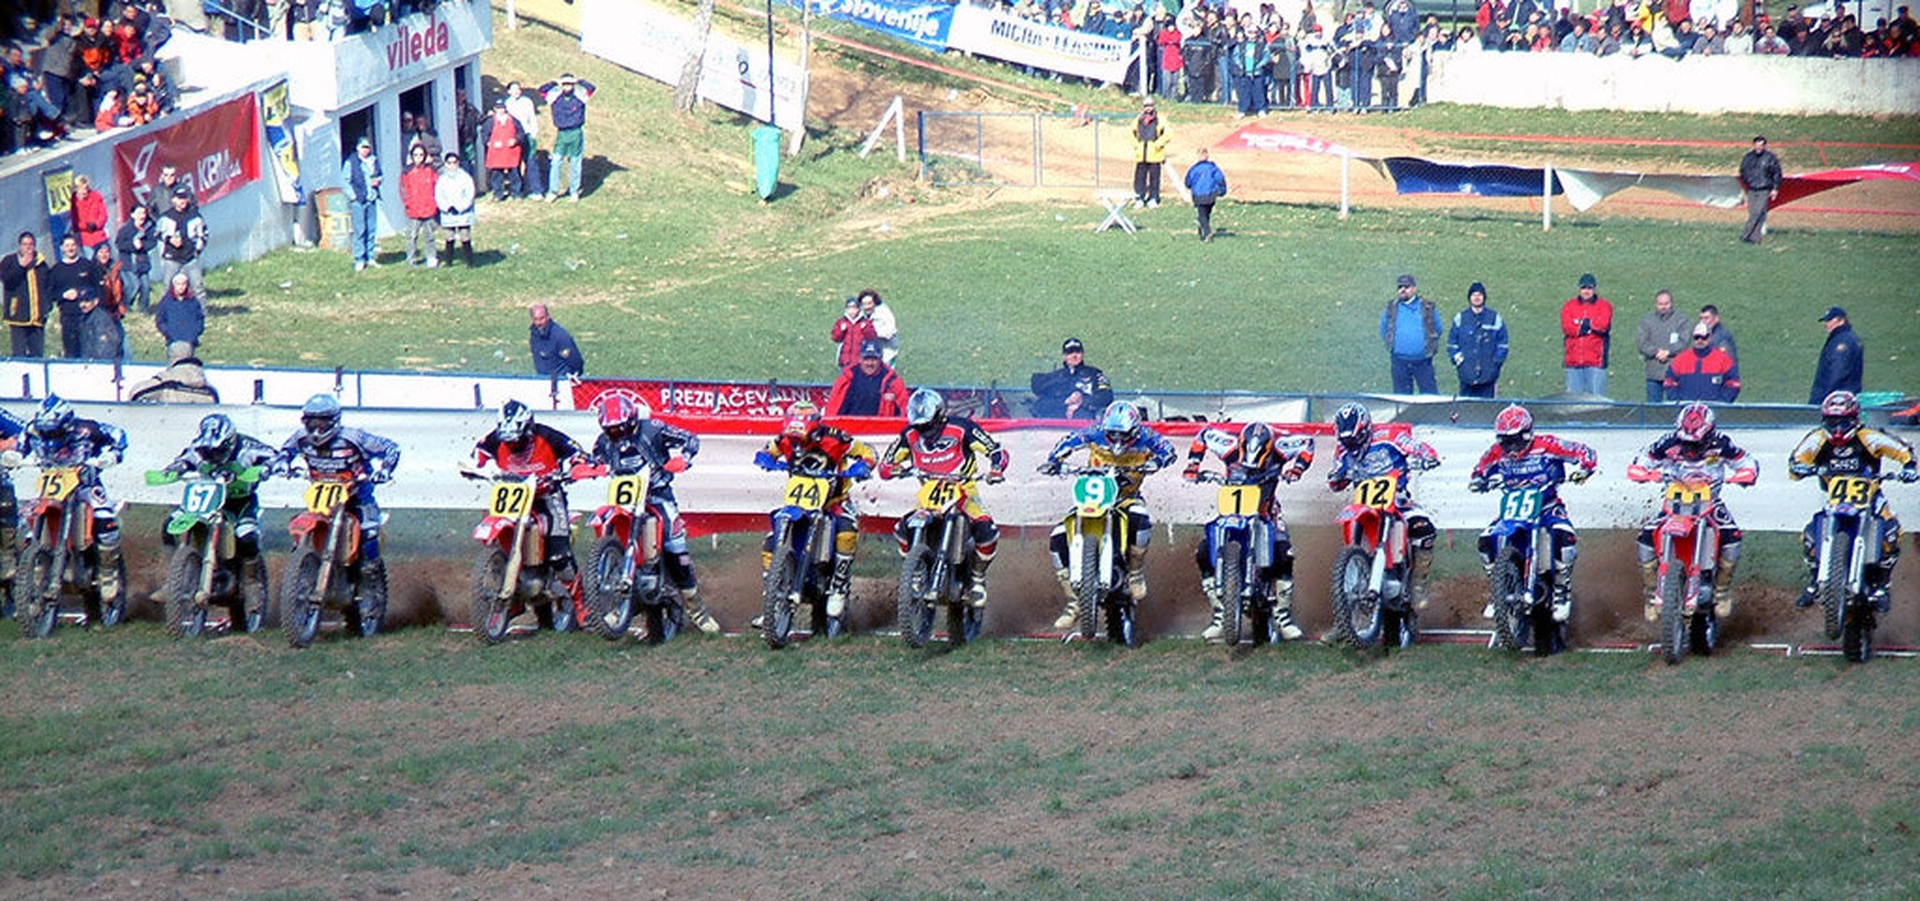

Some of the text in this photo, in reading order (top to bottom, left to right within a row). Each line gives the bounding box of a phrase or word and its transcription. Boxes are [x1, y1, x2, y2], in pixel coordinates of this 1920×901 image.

[386, 13, 449, 71] vileda
[40, 474, 63, 498] 15
[187, 483, 217, 513] 67
[616, 480, 634, 505] 6
[789, 483, 820, 506] 44
[928, 481, 955, 505] 45
[1085, 477, 1106, 505] 9
[1360, 479, 1390, 506] 12
[1830, 479, 1871, 505] 43
[495, 487, 524, 513] 82
[1231, 488, 1242, 515] 1
[1503, 488, 1536, 521] 55
